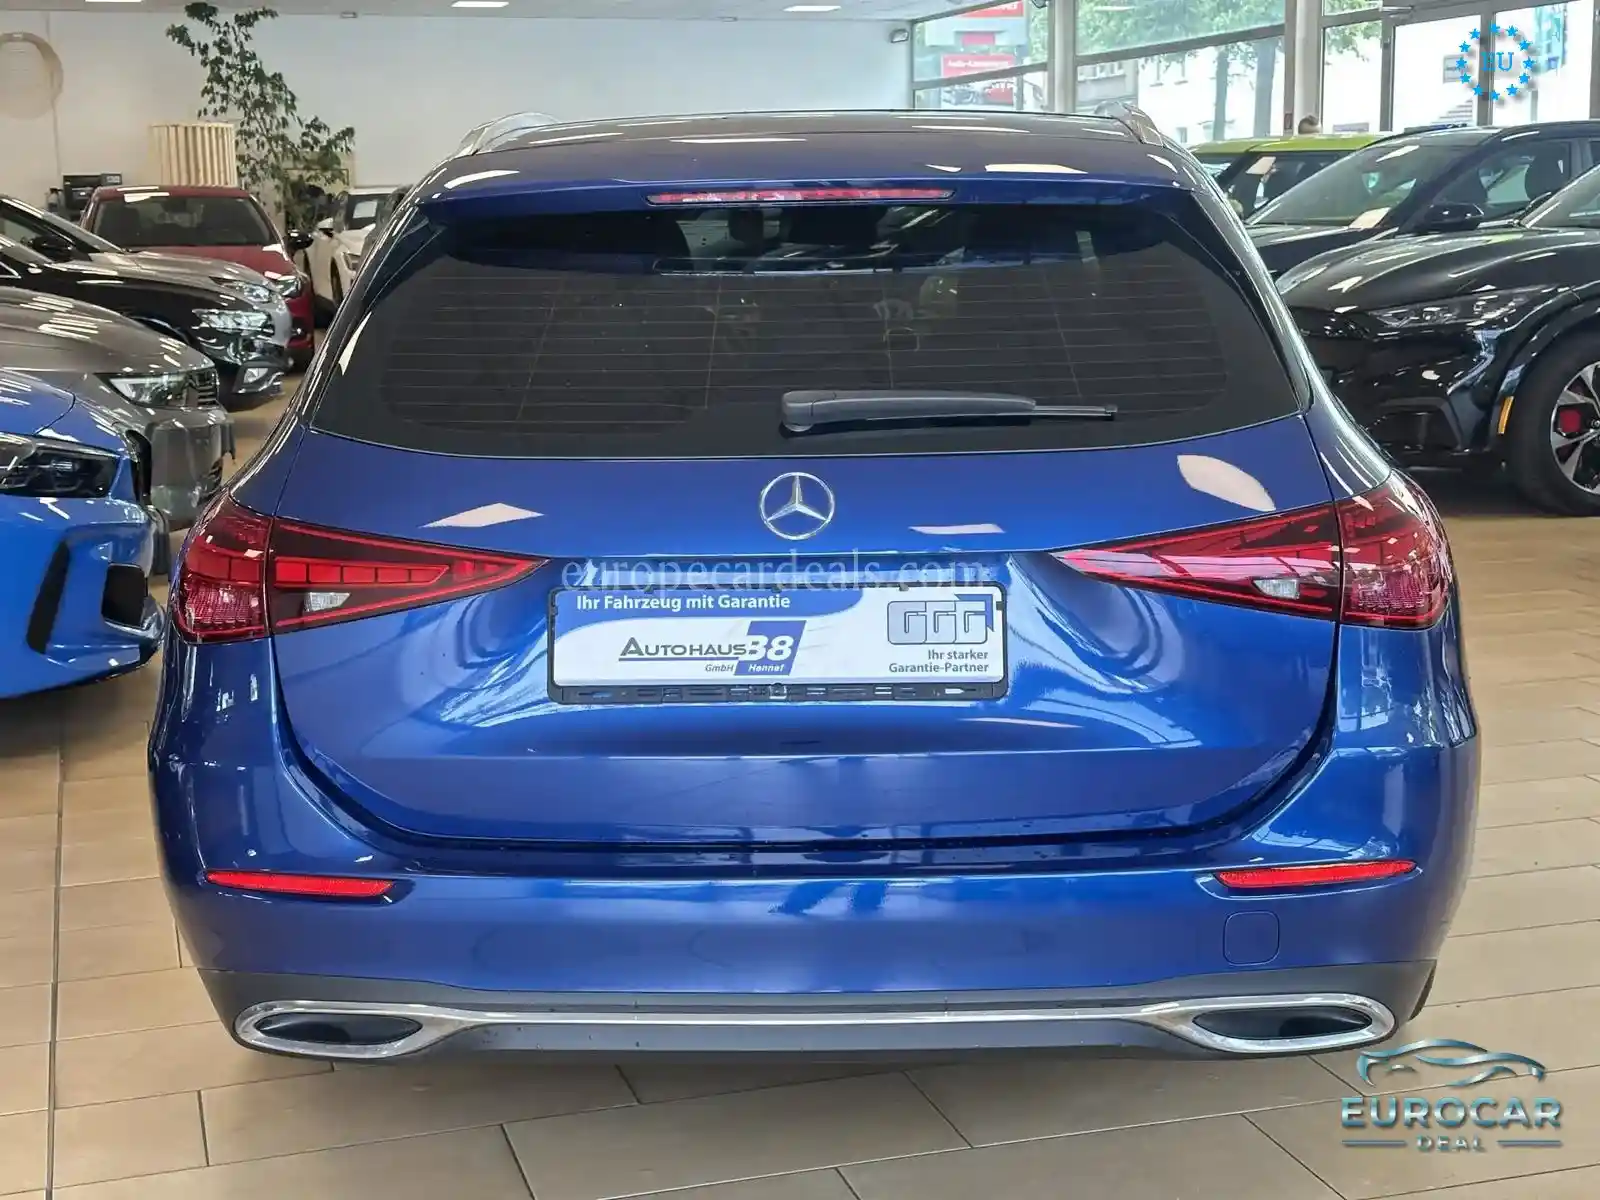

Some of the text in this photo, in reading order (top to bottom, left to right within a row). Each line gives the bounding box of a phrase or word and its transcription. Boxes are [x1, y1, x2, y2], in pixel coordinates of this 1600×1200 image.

[576, 594, 791, 612] Ihr Fahrzeug mit Garantie
[928, 649, 989, 660] Ihr starker
[705, 663, 785, 672] GmbH Hennef
[889, 662, 989, 673] Garantie-Partner
